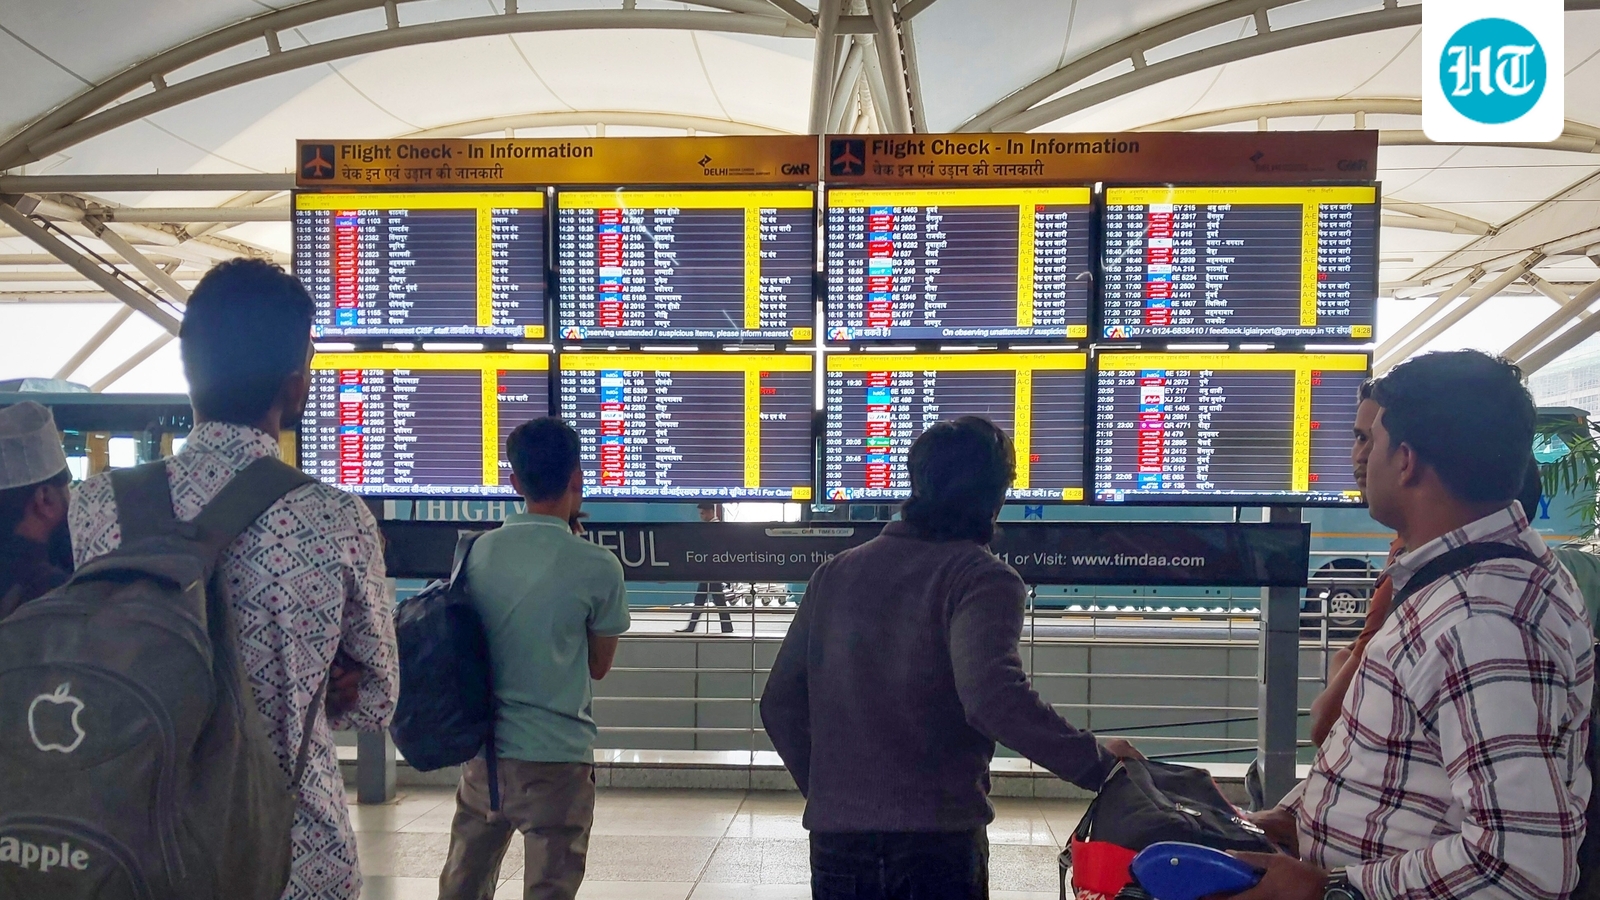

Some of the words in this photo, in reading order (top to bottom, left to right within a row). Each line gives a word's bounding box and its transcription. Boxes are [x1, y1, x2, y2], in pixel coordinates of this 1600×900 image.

[341, 144, 391, 162] Flight
[397, 144, 451, 158] Check
[468, 144, 484, 158] In
[491, 143, 593, 158] Information
[873, 140, 925, 158] Flight
[932, 139, 990, 154] Check
[1008, 139, 1023, 154] In
[1031, 138, 1139, 154] Information
[342, 164, 361, 179] चेक
[366, 168, 381, 180] इन
[385, 164, 400, 179] एवं
[404, 168, 431, 182] उड़ान
[436, 163, 450, 179] की
[455, 163, 504, 179] जानकारी
[704, 168, 728, 176] DELHI
[781, 163, 810, 175] GMR
[874, 161, 893, 176] चेक
[898, 164, 913, 176] इन
[918, 161, 934, 176] एवं
[939, 164, 968, 179] उड़ान
[973, 159, 988, 175] की
[993, 159, 1044, 176] जानकारी
[344, 327, 365, 336] please
[389, 327, 414, 335] nearest
[616, 328, 652, 337] unattended
[658, 329, 693, 337] suspicious
[695, 329, 715, 338] items,
[717, 329, 739, 338] please
[741, 329, 761, 337] inform
[763, 329, 788, 337] nearest
[943, 328, 953, 336] On
[956, 328, 988, 338] observing
[990, 328, 1028, 336] unattended
[1048, 490, 1060, 498] For
[686, 551, 708, 562] For
[713, 551, 785, 565] advertising
[790, 553, 806, 562] on
[811, 551, 835, 563] this
[1015, 554, 1029, 565] or
[1033, 553, 1067, 565] Visit:
[1072, 553, 1205, 566] www.timdaa.com
[0, 836, 89, 872] apple
